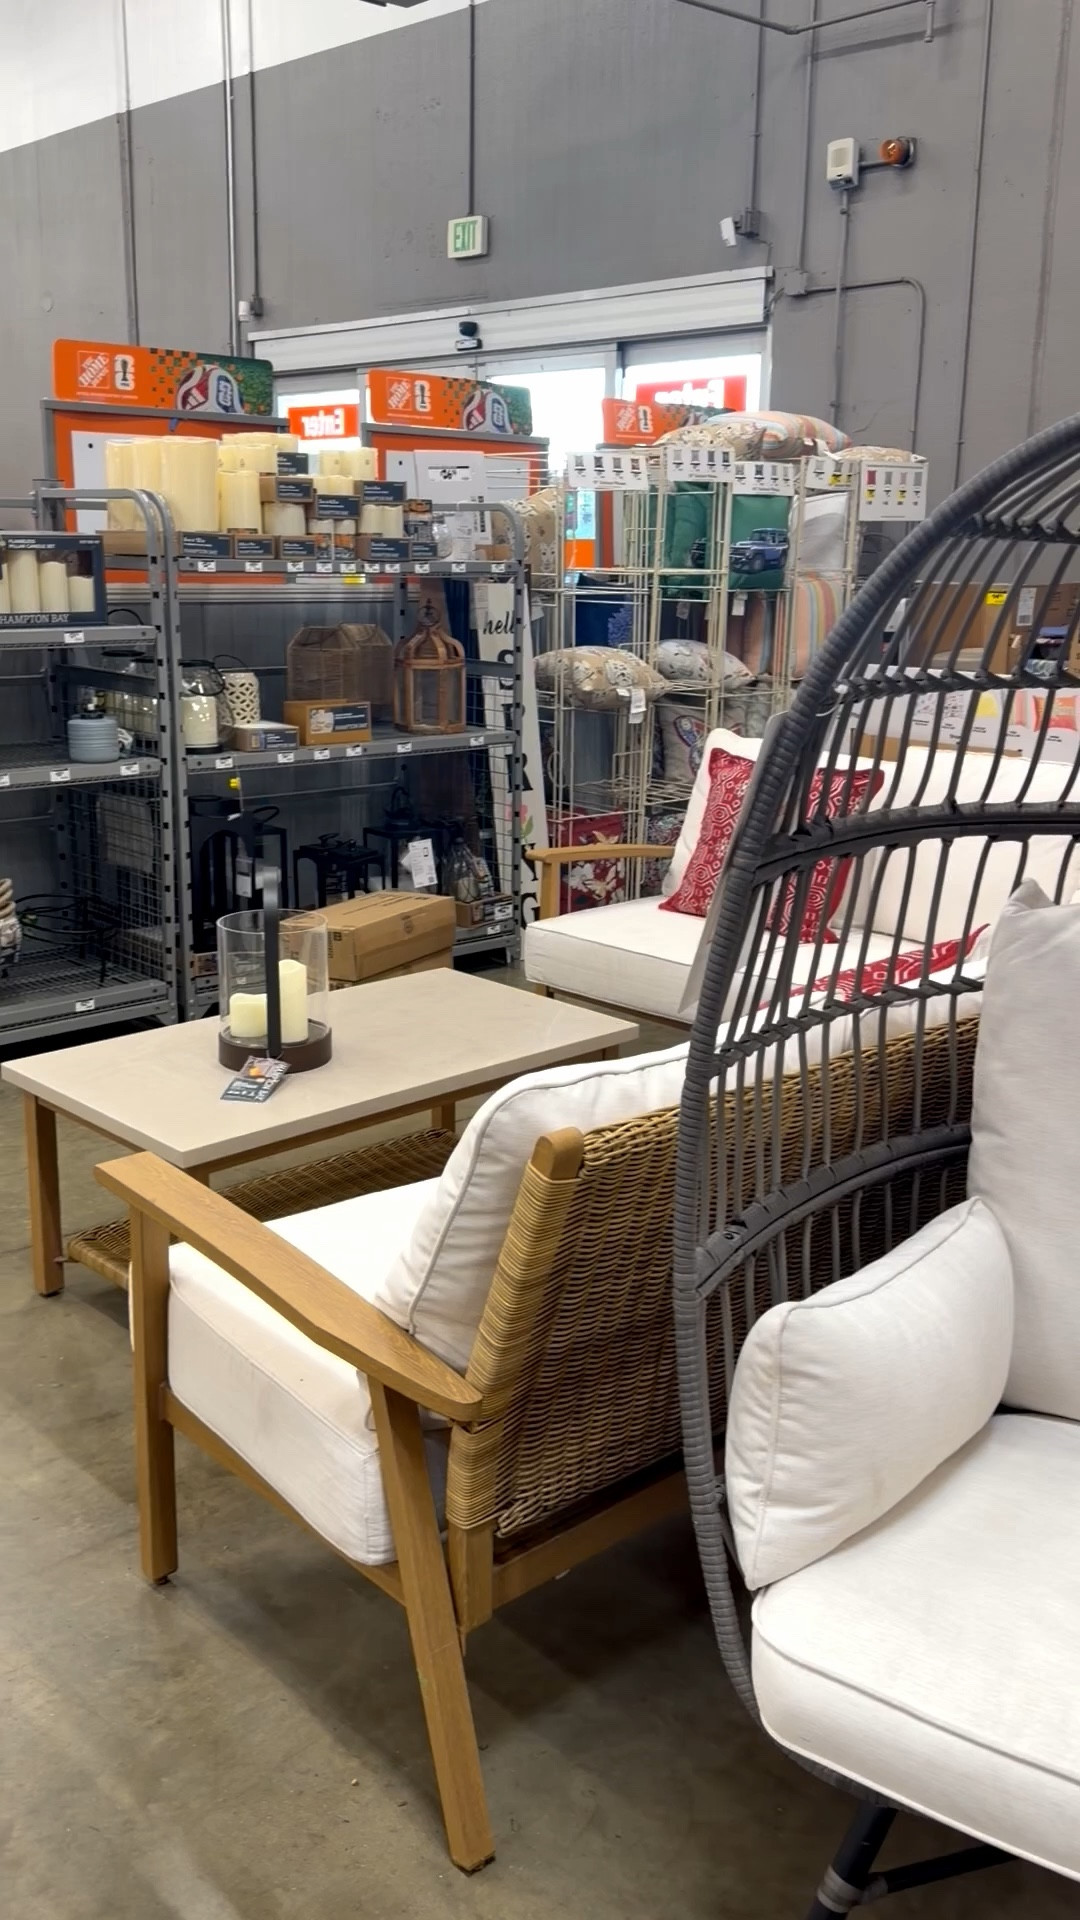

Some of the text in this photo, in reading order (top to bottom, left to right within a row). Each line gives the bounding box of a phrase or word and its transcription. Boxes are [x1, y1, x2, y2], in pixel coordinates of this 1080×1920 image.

[454, 221, 478, 252] EXIT
[0, 613, 69, 625] HAMPTON BAY
